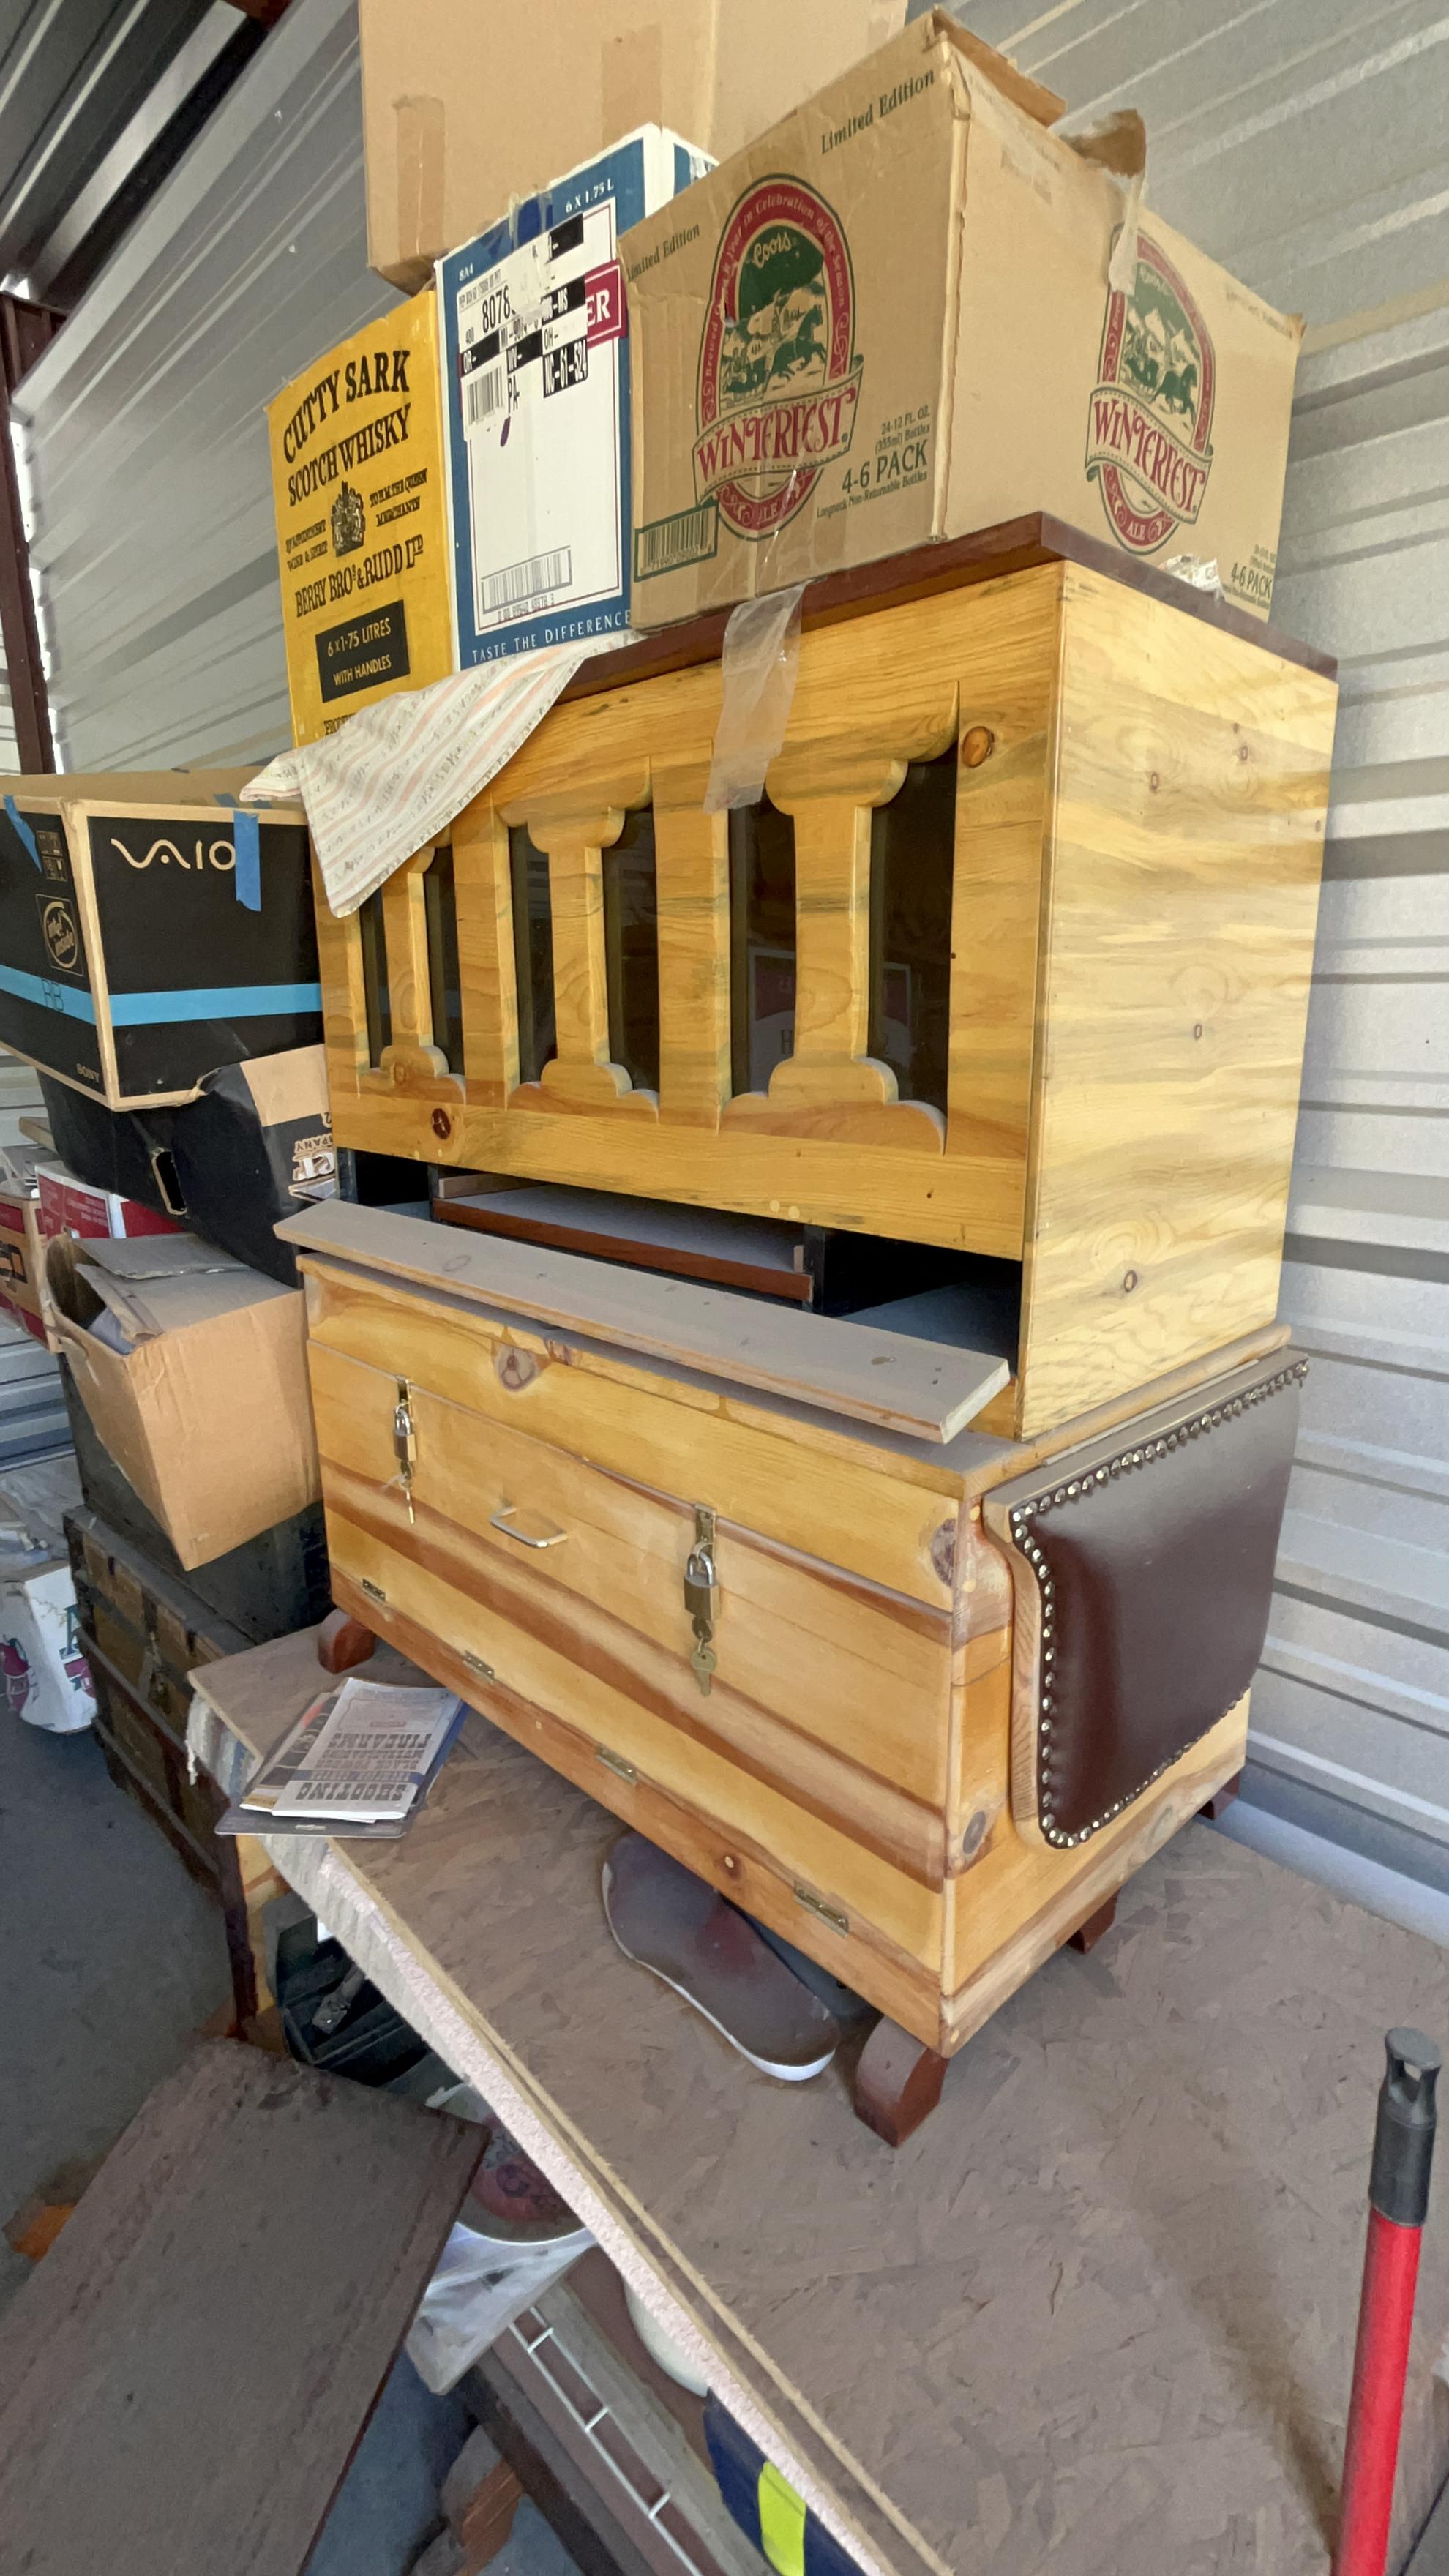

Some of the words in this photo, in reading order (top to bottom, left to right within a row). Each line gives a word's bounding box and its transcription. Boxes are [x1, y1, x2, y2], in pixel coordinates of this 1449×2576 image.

[821, 103, 873, 155] Limited
[879, 69, 934, 118] Edition
[662, 223, 700, 258] Edition
[753, 231, 793, 269] Coors
[283, 369, 340, 464] CUTTY
[345, 349, 411, 403] SARK
[697, 386, 857, 482] WINTERFEST
[288, 445, 340, 507] SCOTCH
[338, 402, 411, 472] WHISKY
[842, 460, 871, 494] 4-6
[876, 439, 928, 483] PACK
[1094, 399, 1208, 513] WINTERFEST
[1126, 521, 1146, 540] ALE
[295, 577, 326, 618] BERRY
[363, 543, 404, 587] RUDD
[1247, 569, 1273, 599] PACK
[327, 640, 334, 656] 6
[362, 617, 392, 645] LITRES
[472, 642, 507, 664] TASTE
[514, 633, 538, 652] THE
[544, 609, 631, 645] DIFFERENCE
[333, 667, 354, 687] WITH
[354, 654, 392, 680] HANDLES
[111, 838, 236, 871] VAIO
[328, 1732, 433, 1749] FIREARMS
[295, 1781, 408, 1801] SHOOTING
